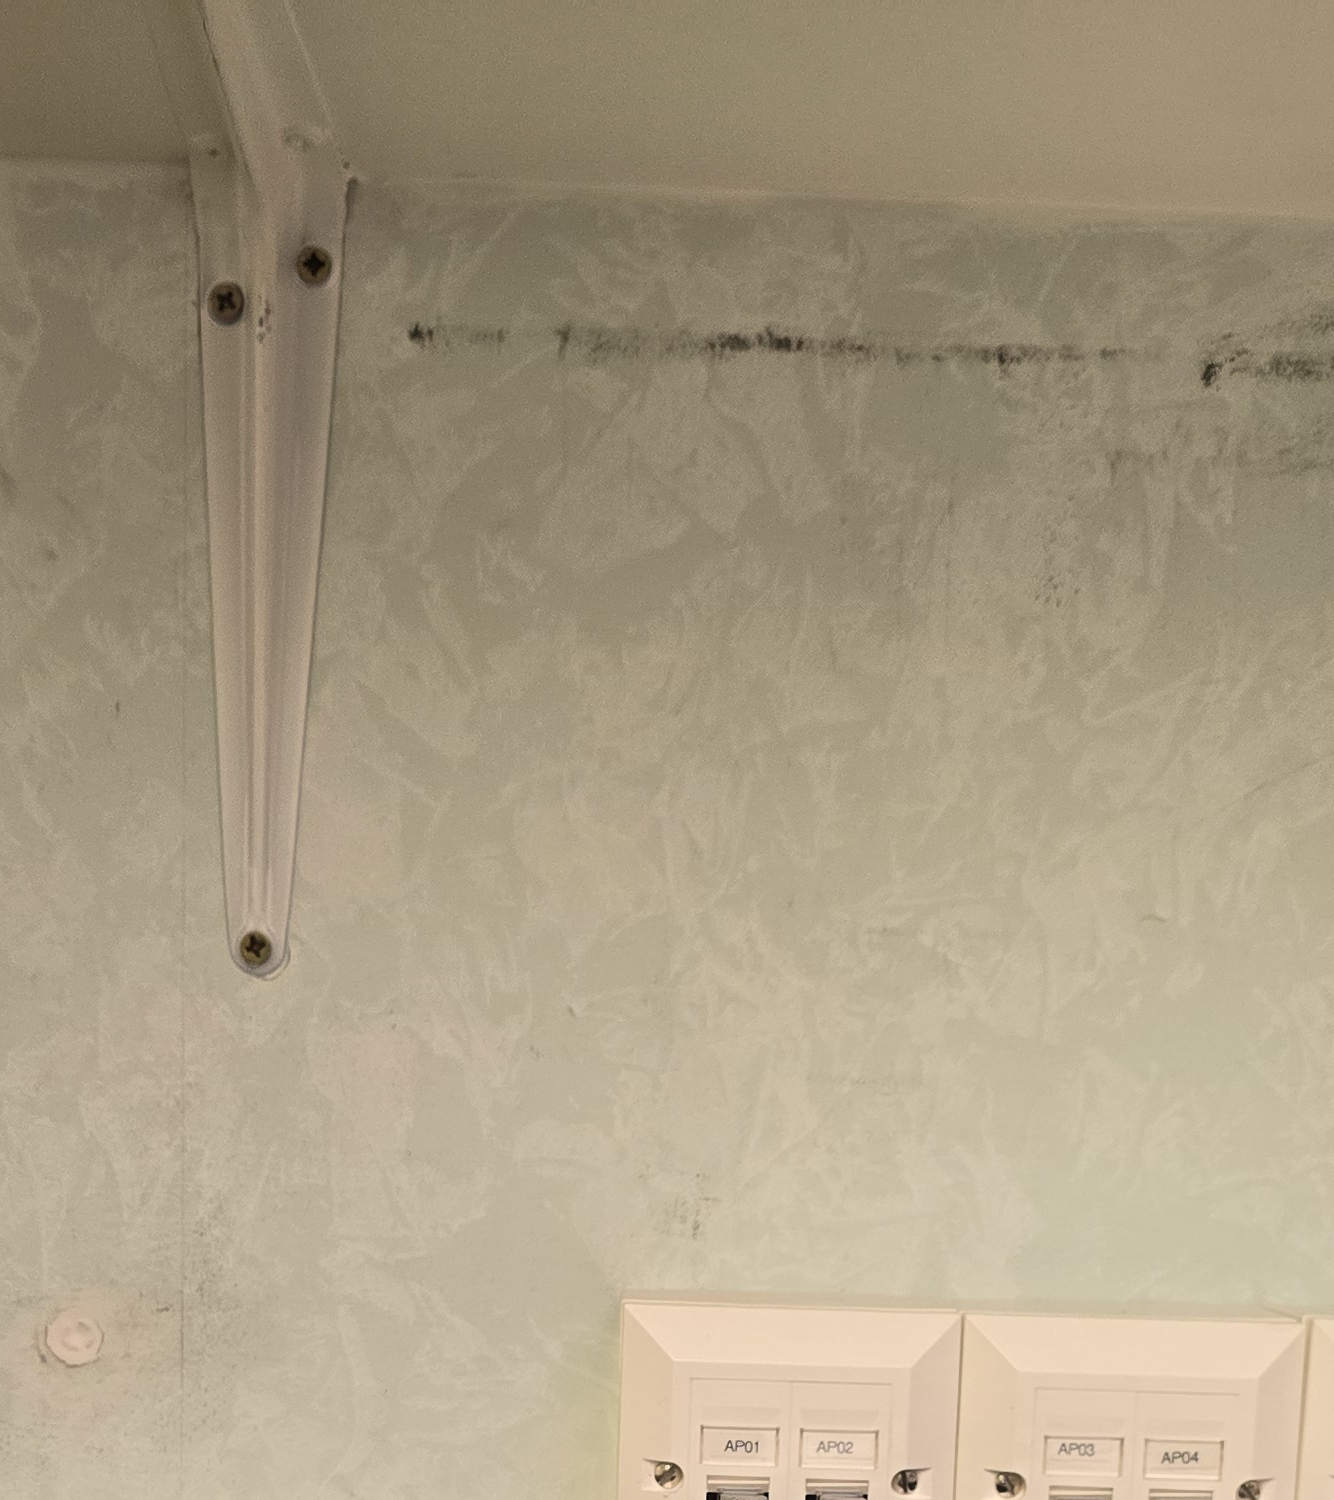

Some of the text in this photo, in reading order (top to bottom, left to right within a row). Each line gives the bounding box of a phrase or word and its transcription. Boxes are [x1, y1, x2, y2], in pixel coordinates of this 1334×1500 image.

[723, 1439, 759, 1454] AP01
[815, 1440, 854, 1455] AP02
[1057, 1442, 1096, 1458] AP03
[1160, 1450, 1199, 1465] AP04
